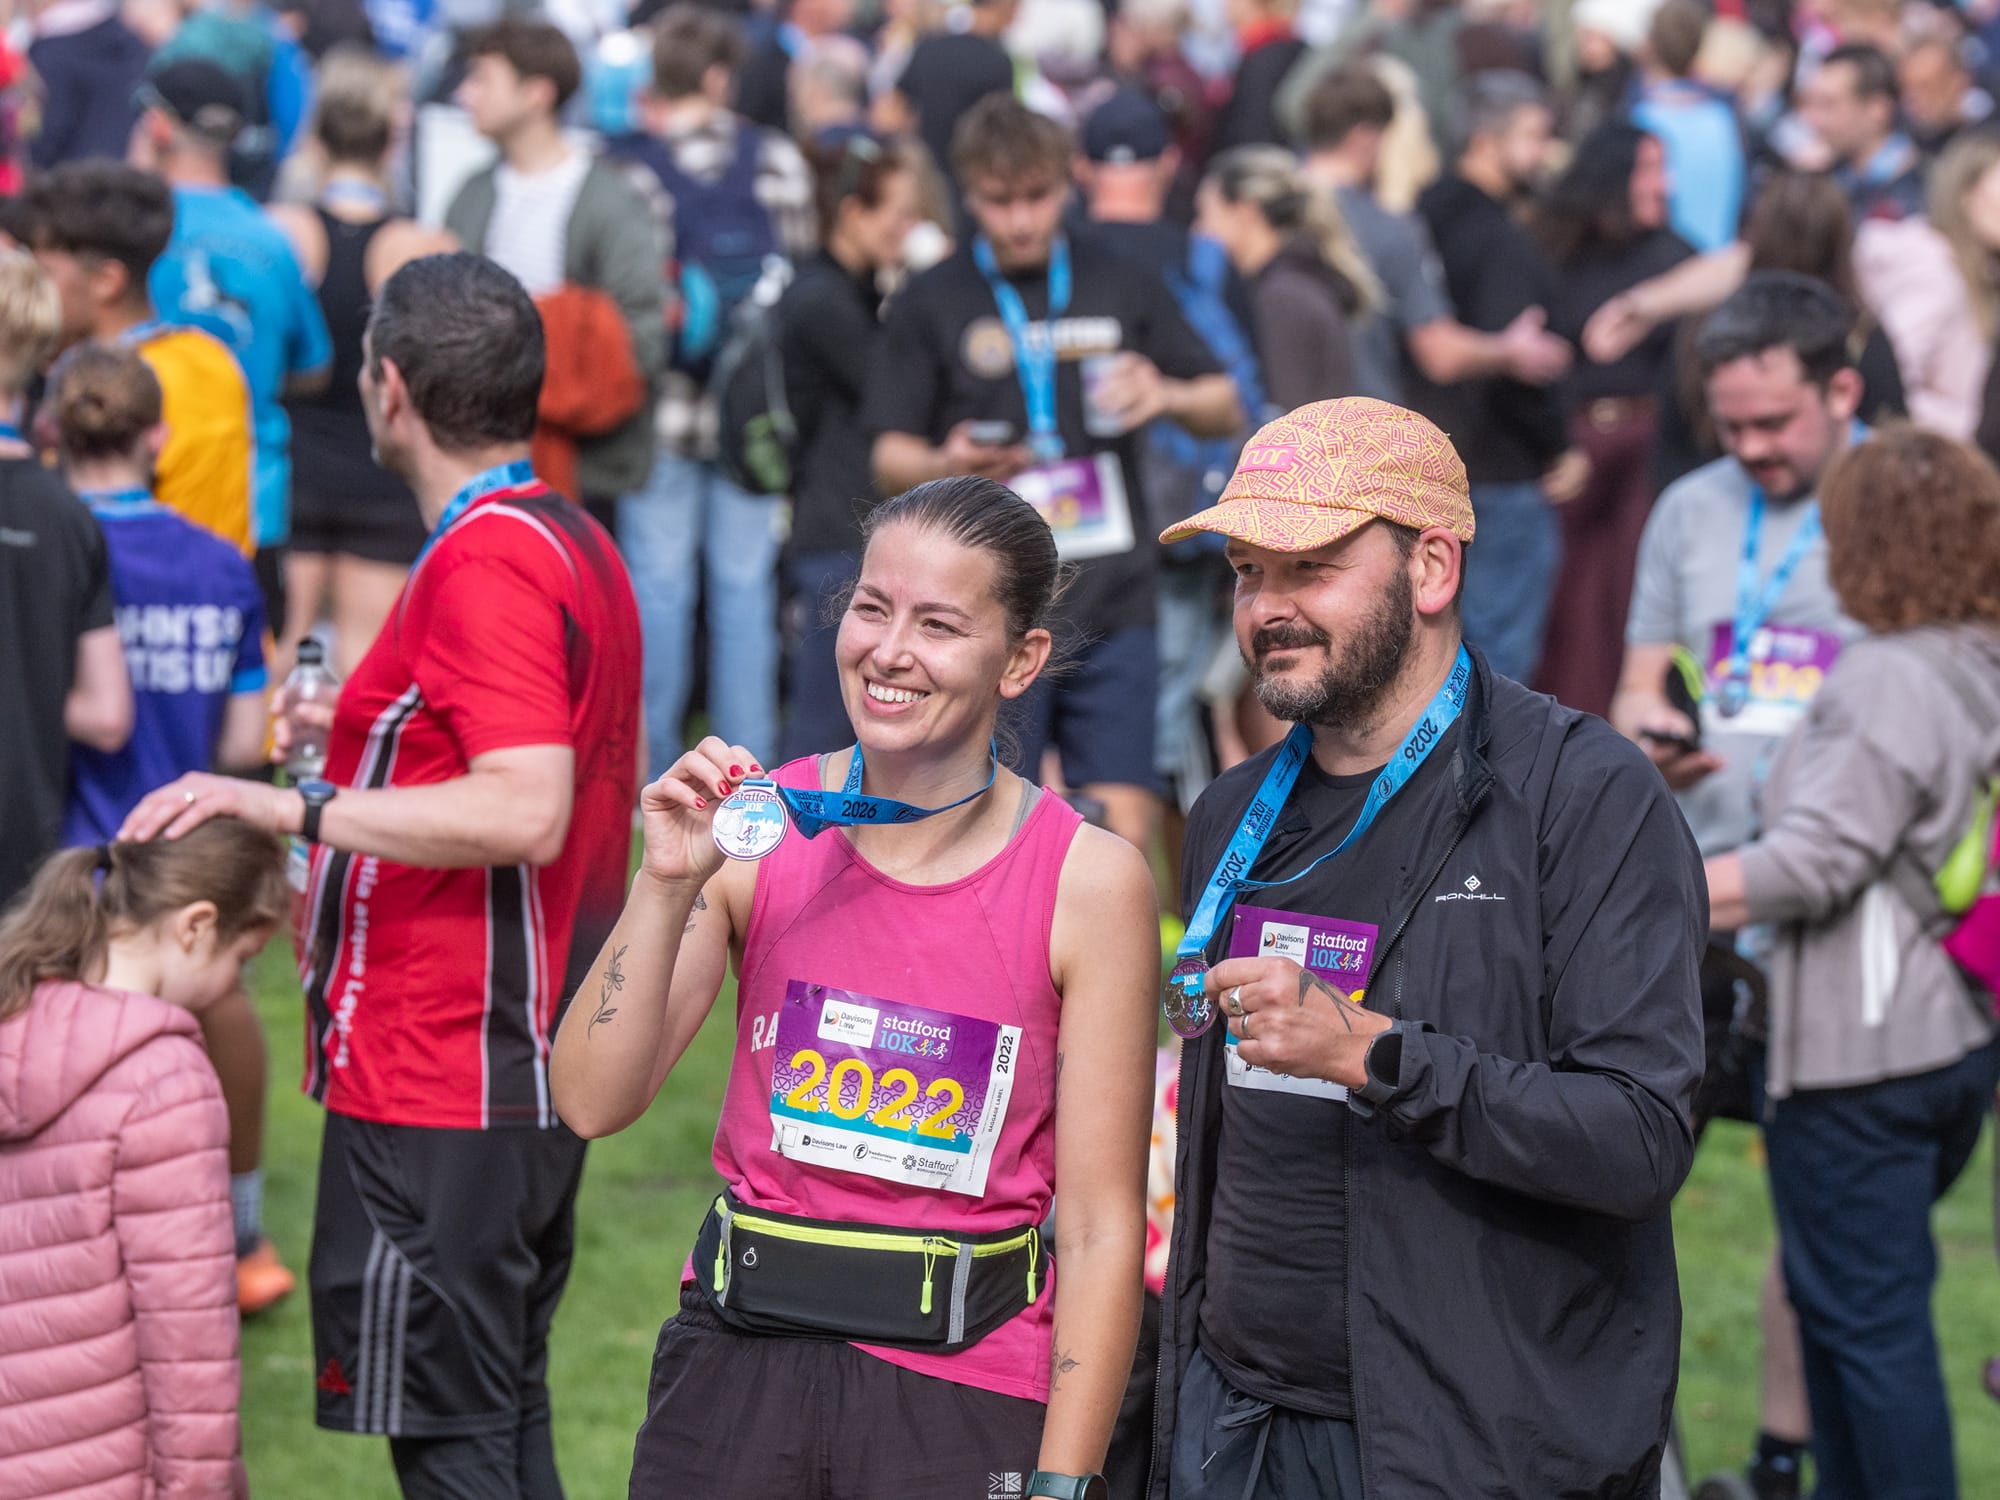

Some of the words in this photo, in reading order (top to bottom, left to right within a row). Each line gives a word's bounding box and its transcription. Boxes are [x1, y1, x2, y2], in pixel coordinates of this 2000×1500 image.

[1404, 717, 1438, 762] 2026
[734, 791, 778, 803] stafford
[745, 802, 764, 812] 10K
[842, 800, 877, 819] 2026
[1249, 798, 1267, 822] 10K
[1254, 807, 1275, 842] stafford
[1435, 892, 1505, 902] RONHILL
[1275, 942, 1289, 950] Law
[1276, 933, 1305, 944] Davisons
[1312, 932, 1367, 952] stafford
[1310, 948, 1342, 969] 10K
[1183, 975, 1198, 986] 10K
[839, 1020, 855, 1030] Law
[841, 1012, 873, 1025] Davisons
[882, 1016, 952, 1041] stafford
[878, 1030, 918, 1054] 10K
[997, 1035, 1014, 1074] 2022
[786, 1049, 964, 1140] 2022
[988, 1107, 999, 1133] BAGGAGE
[995, 1088, 1004, 1106] LABEL
[812, 1138, 835, 1149] Davisons
[835, 1142, 848, 1151] Law
[918, 1157, 956, 1172] Stafford
